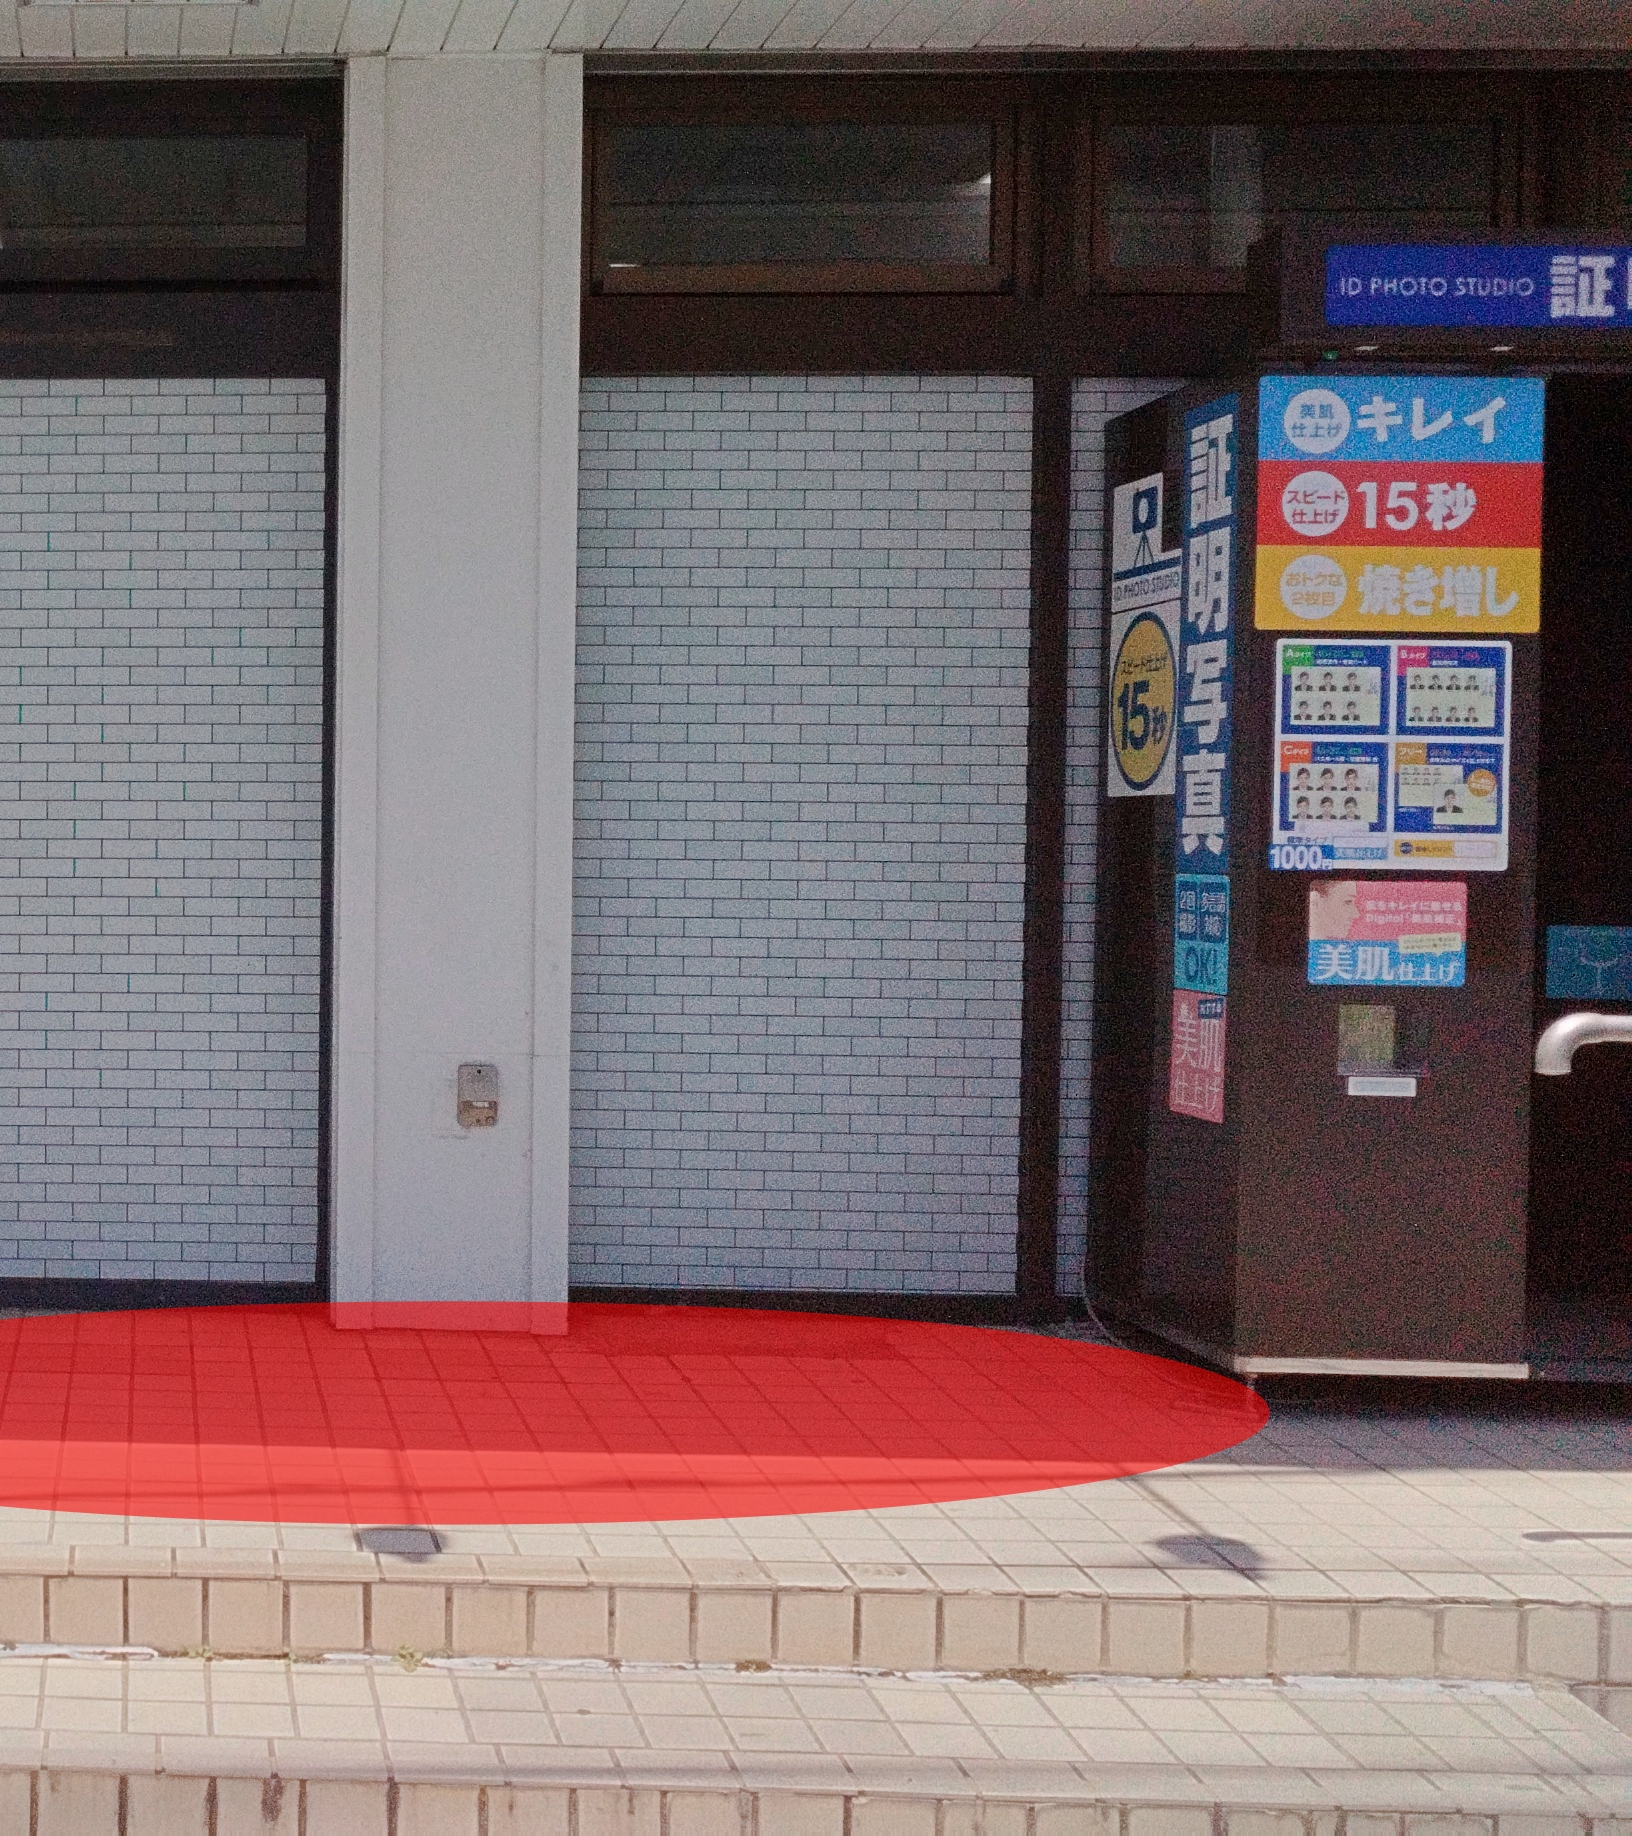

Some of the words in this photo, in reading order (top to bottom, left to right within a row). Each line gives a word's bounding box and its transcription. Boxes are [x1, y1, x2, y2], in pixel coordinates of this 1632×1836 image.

[1340, 277, 1362, 296] ID
[1371, 277, 1447, 297] PHOTO
[1456, 277, 1534, 297] STUDIO
[1357, 395, 1506, 445] キレイ
[1286, 489, 1346, 505] スピード
[1291, 508, 1340, 525] 仕上げ
[1356, 481, 1477, 531] 15秒
[1357, 564, 1518, 617] 焼き増し
[1180, 413, 1234, 857] 証明写真
